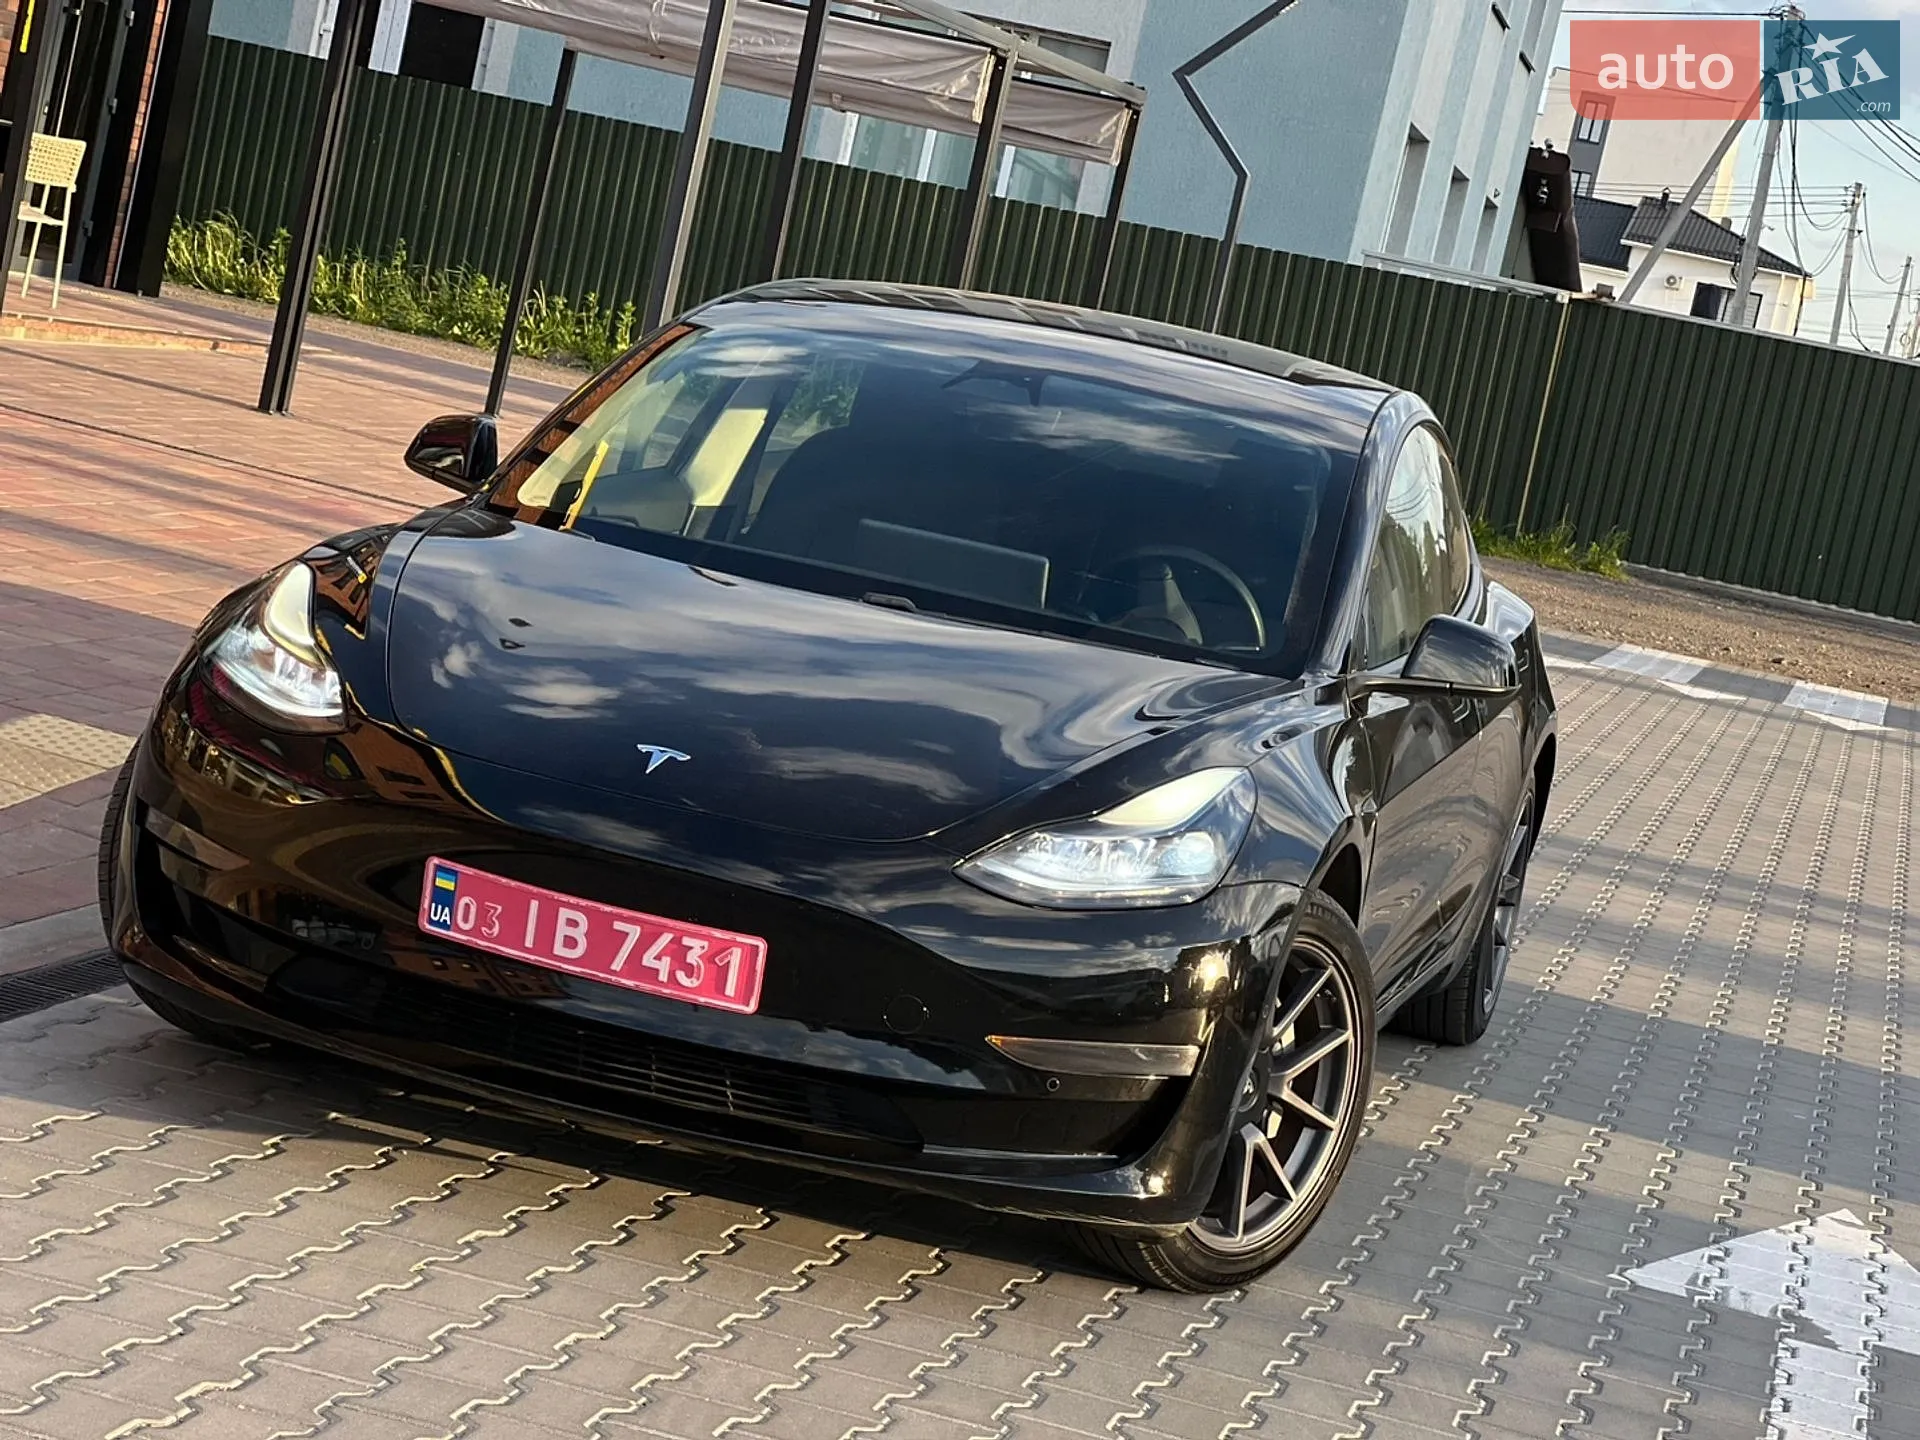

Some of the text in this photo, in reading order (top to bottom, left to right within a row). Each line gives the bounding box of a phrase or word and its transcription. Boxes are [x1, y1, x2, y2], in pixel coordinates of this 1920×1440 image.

[430, 903, 451, 925] UA
[456, 895, 502, 939] 03
[610, 921, 743, 998] 7431
